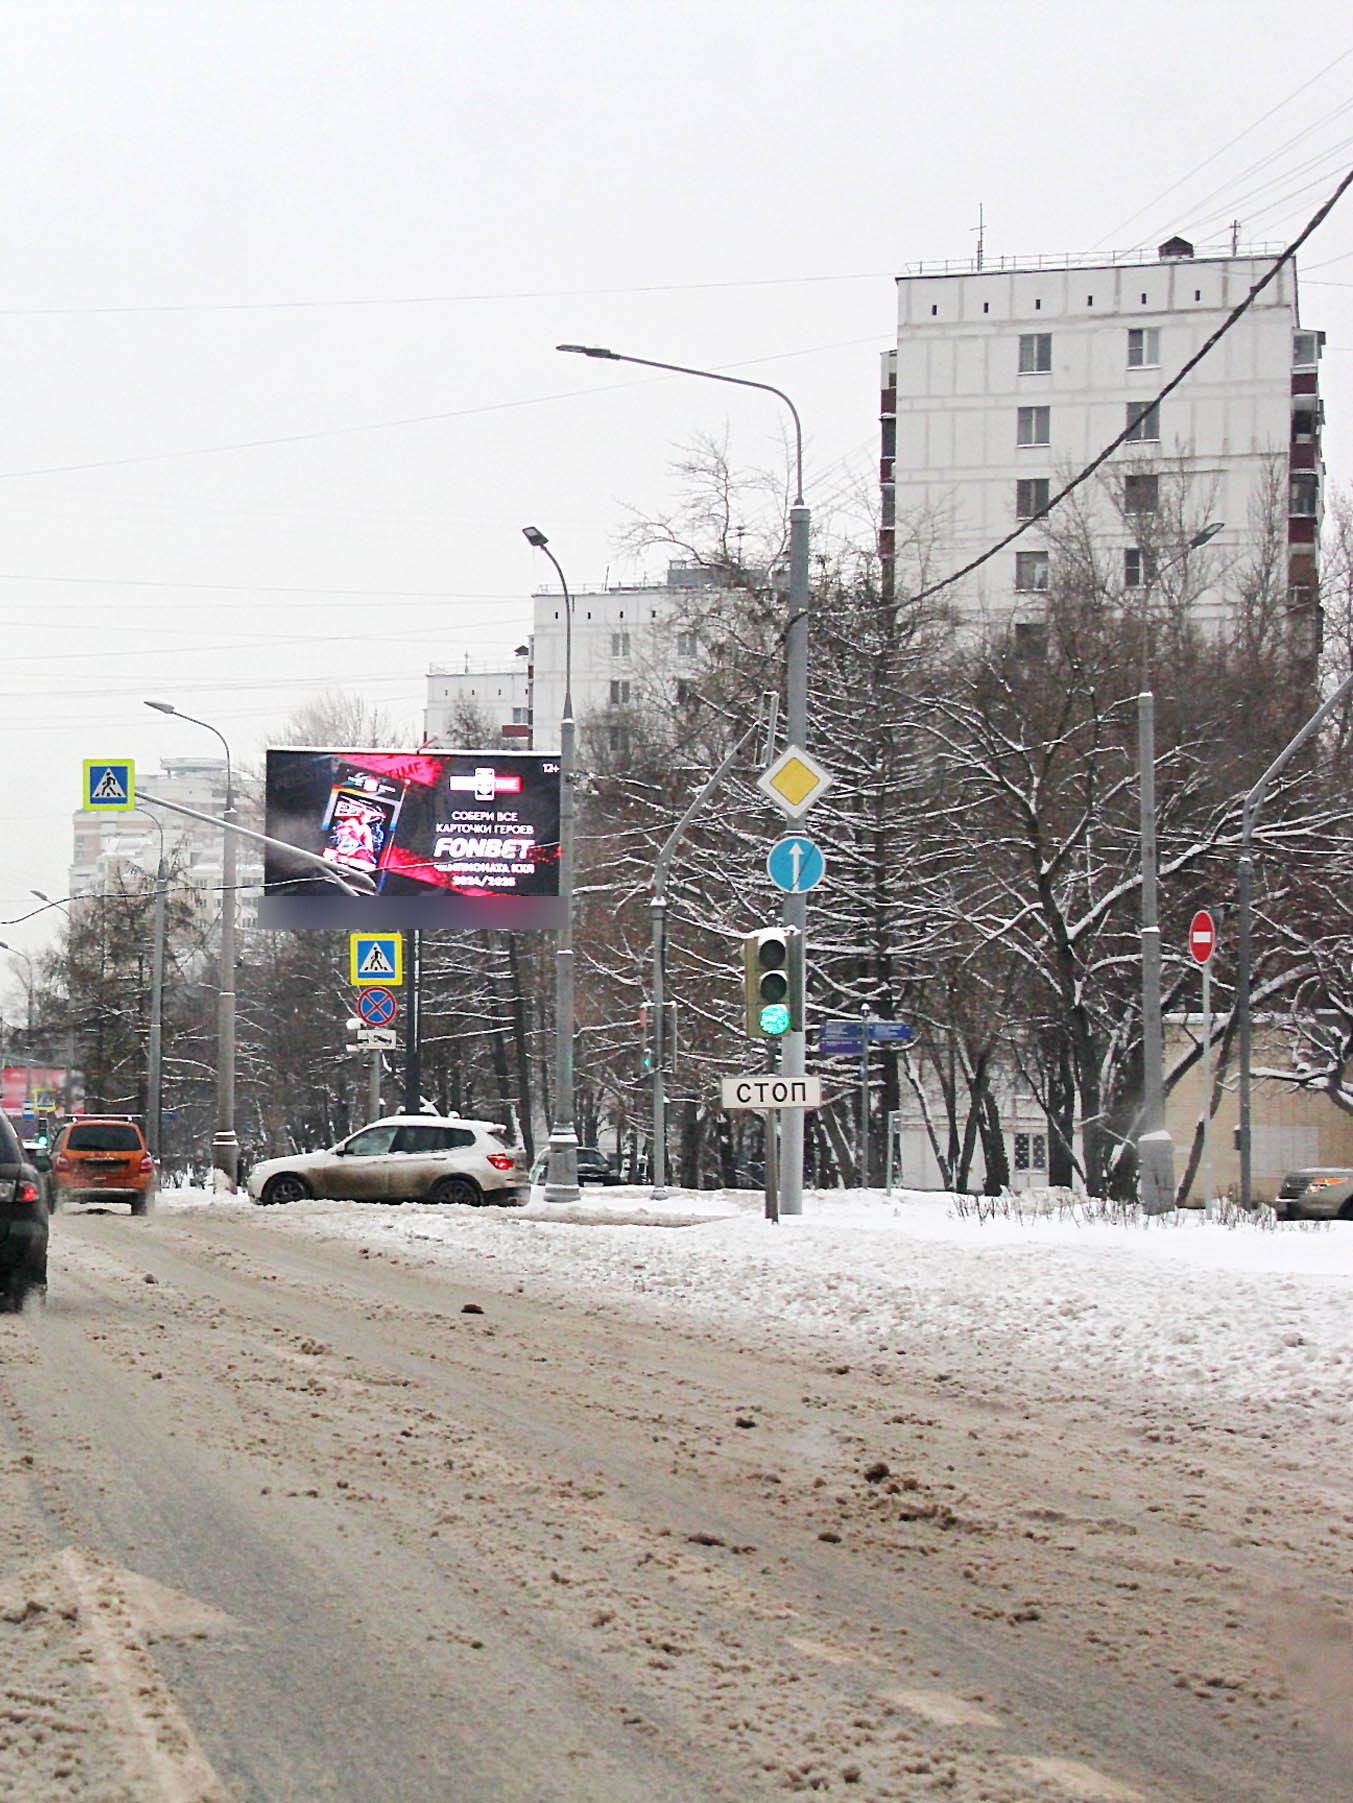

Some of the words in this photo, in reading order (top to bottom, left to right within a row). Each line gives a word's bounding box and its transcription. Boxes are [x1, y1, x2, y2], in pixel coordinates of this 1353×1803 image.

[542, 763, 560, 773] 12+
[451, 811, 495, 821] СОБЕРИ
[497, 812, 518, 822] ВСЕ
[436, 823, 492, 834] КАРТОЧКИ
[494, 824, 535, 835] ГЕРОЕВ
[433, 837, 535, 860] FONBET
[736, 1082, 806, 1103] СТОП
